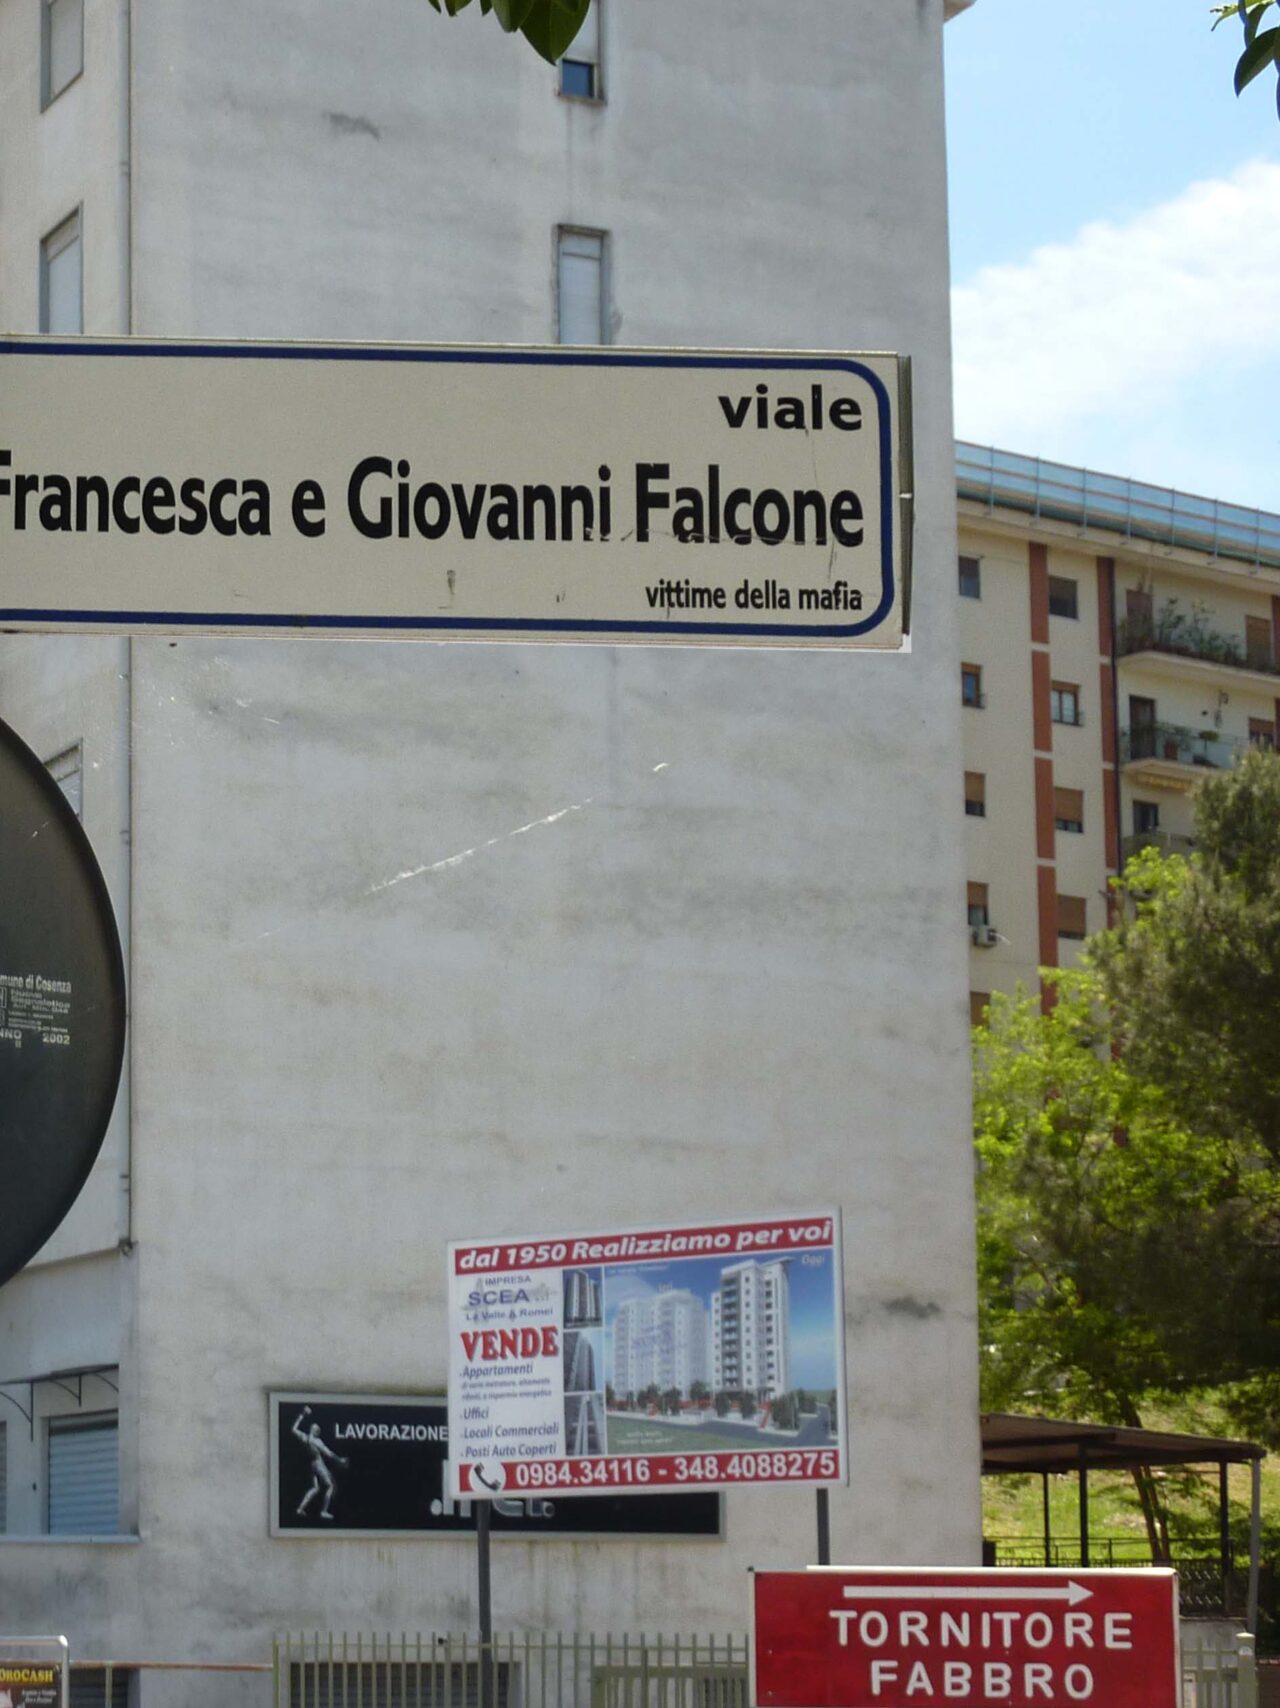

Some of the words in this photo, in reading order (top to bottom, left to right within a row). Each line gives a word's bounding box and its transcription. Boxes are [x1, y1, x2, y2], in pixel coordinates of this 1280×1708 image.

[718, 383, 862, 431] viale
[291, 478, 326, 537] e
[347, 456, 611, 541] Giovanni
[635, 463, 864, 547] Falcone
[645, 578, 727, 608] vittime
[734, 579, 790, 609] della
[798, 580, 862, 610] mafia
[25, 974, 34, 989] di
[35, 975, 71, 993] Cosenza
[42, 1032, 71, 1045] 2002
[460, 1248, 499, 1269] dal
[507, 1243, 567, 1265] 1950
[572, 1233, 731, 1260] Realizziamo
[735, 1226, 783, 1250] per
[787, 1220, 831, 1242] voi
[485, 1275, 532, 1286] IMPRESA
[468, 1289, 530, 1306] SCEA
[460, 1325, 559, 1362] VENDE
[463, 1362, 533, 1378] Appartamenti
[463, 1406, 489, 1420] Uffici
[335, 1422, 449, 1441] LAVORAZIONE
[464, 1425, 493, 1439] Locali
[495, 1422, 560, 1438] Commerciali
[465, 1445, 490, 1458] Posti
[492, 1444, 516, 1457] Auto
[518, 1441, 557, 1458] Coperti
[516, 1458, 650, 1487] 0984.34116
[674, 1452, 835, 1481] 348.4088275
[829, 1610, 1133, 1649] TORNITORE
[871, 1660, 1094, 1699] FABBRO
